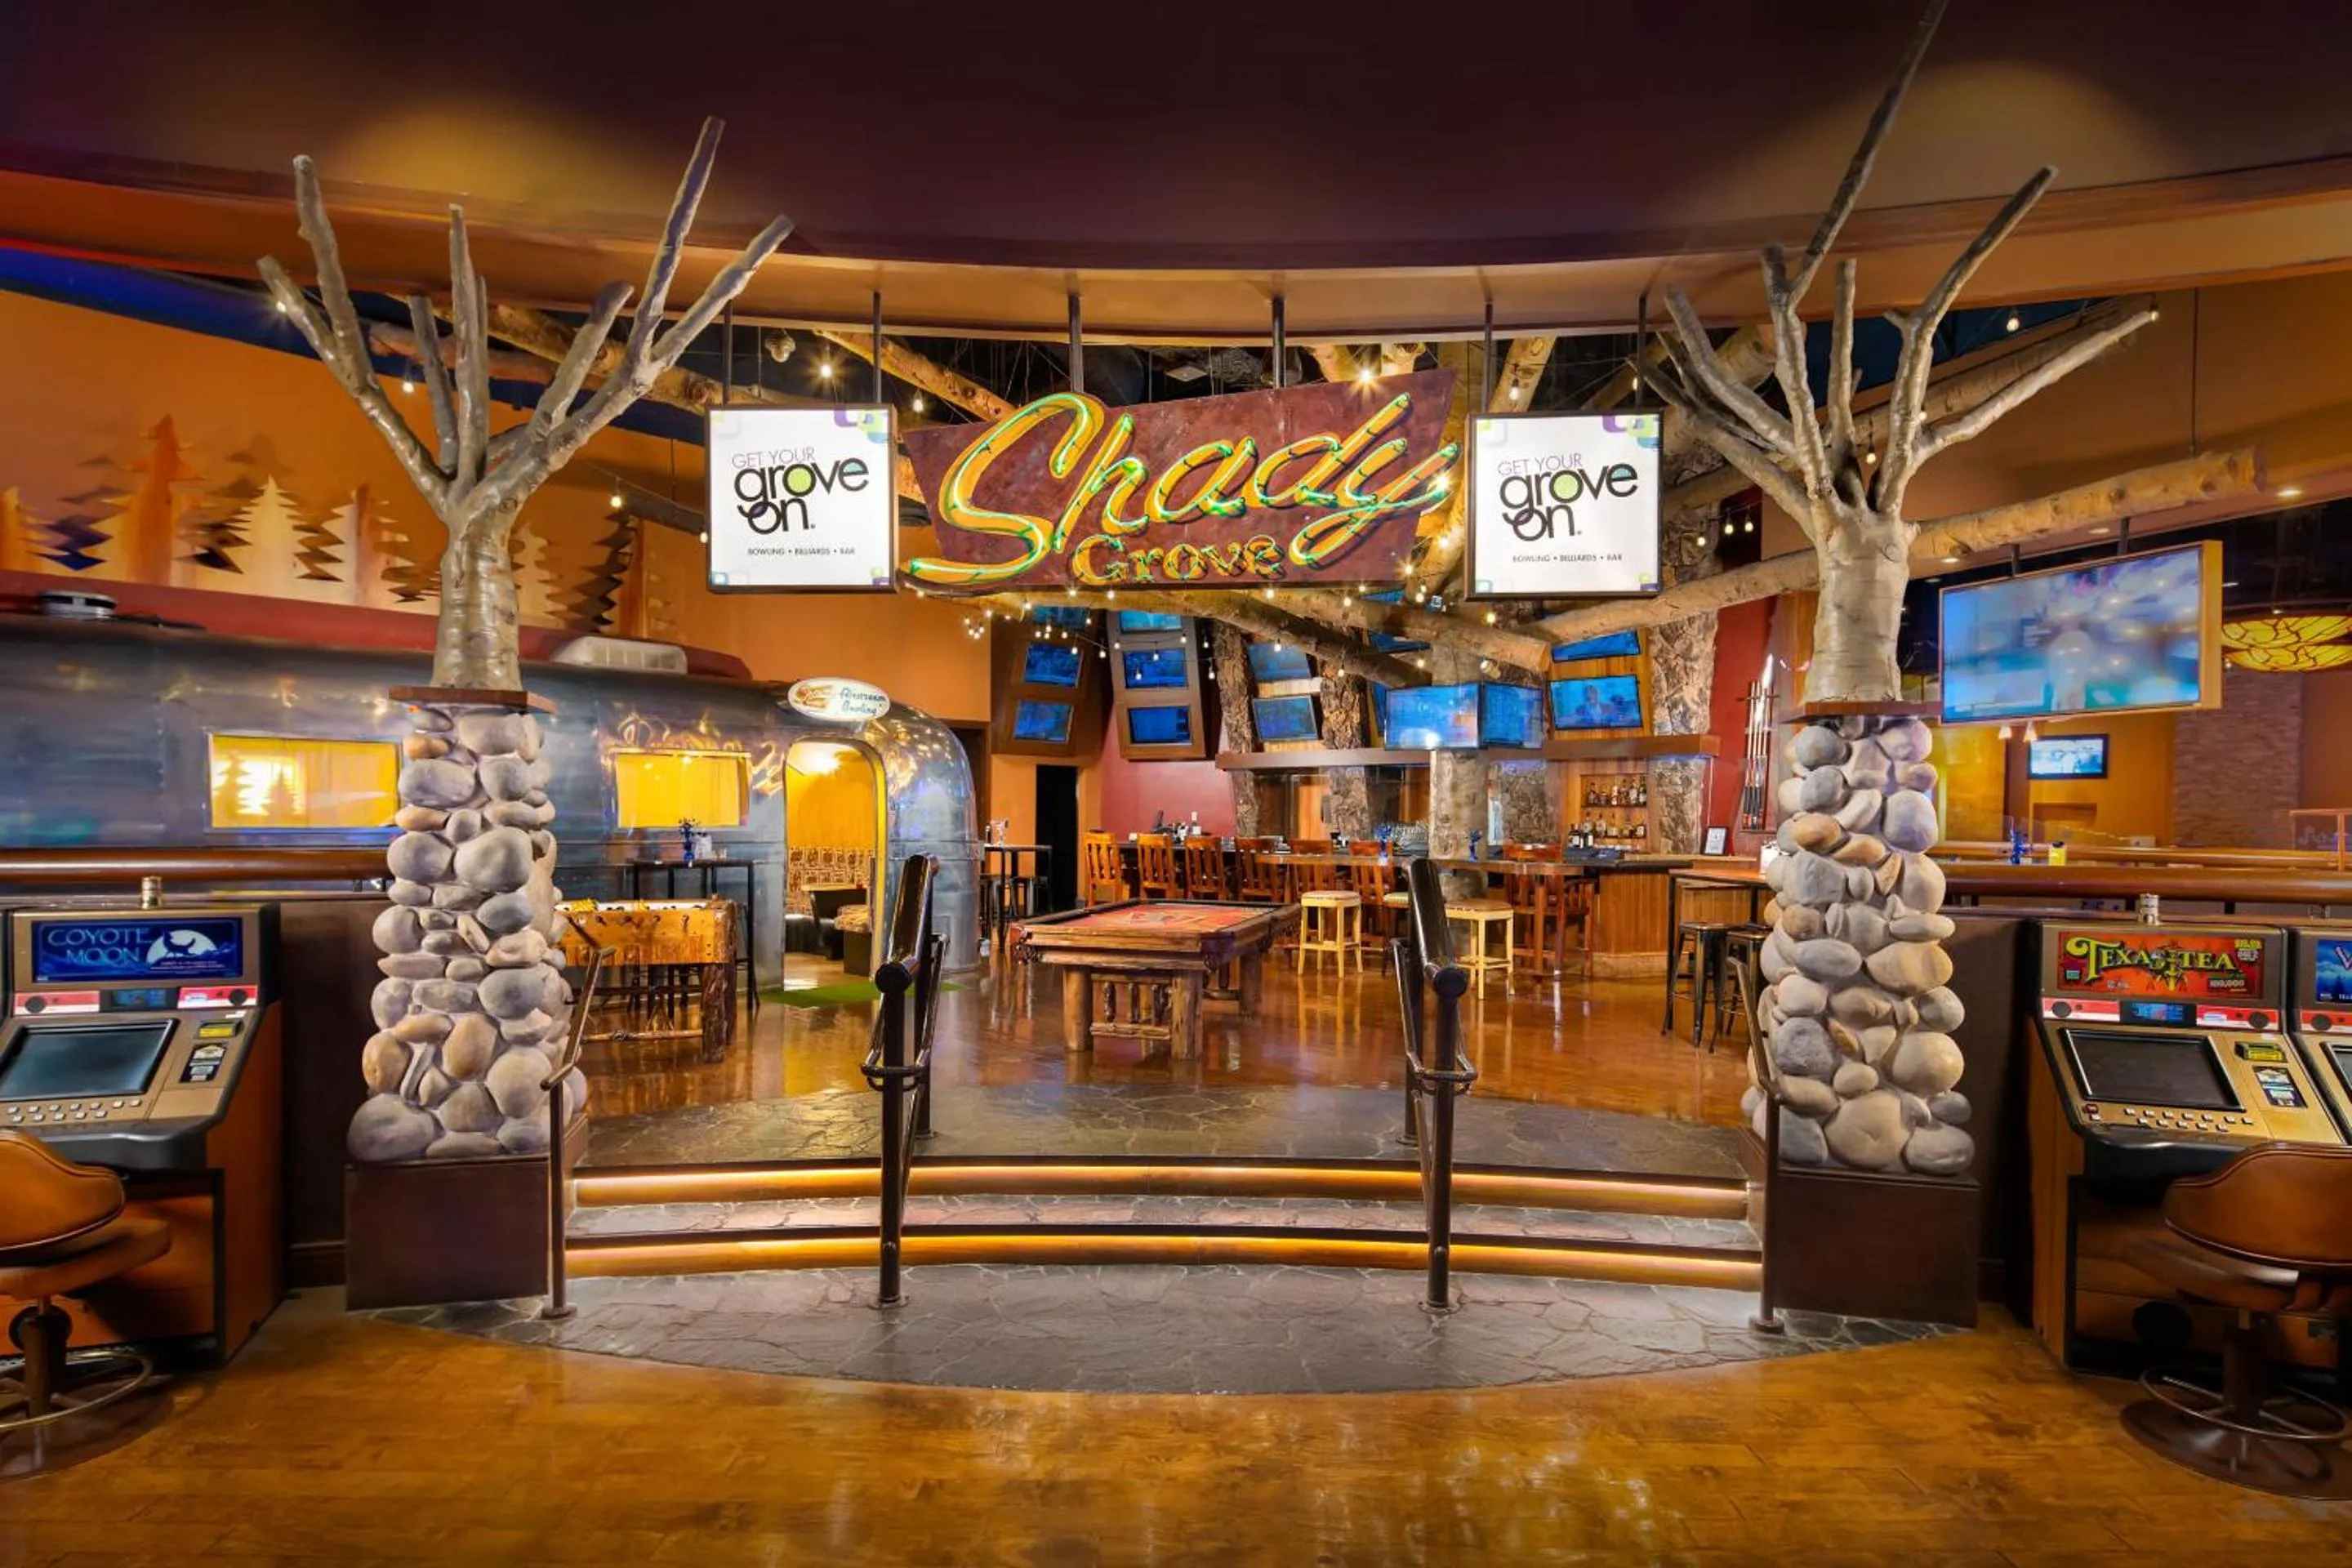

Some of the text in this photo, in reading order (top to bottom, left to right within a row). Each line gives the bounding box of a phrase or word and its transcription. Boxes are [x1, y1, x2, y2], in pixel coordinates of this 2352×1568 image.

[732, 446, 816, 468] GET YOUR
[1497, 452, 1583, 475] GET YOUR
[734, 457, 870, 518] grove
[908, 392, 1462, 583] Shady
[1499, 462, 1638, 525] grove
[1072, 534, 1285, 586] Grove
[48, 927, 150, 947] COYOTE
[66, 947, 140, 965] MOON
[2177, 951, 2236, 970] TEA
